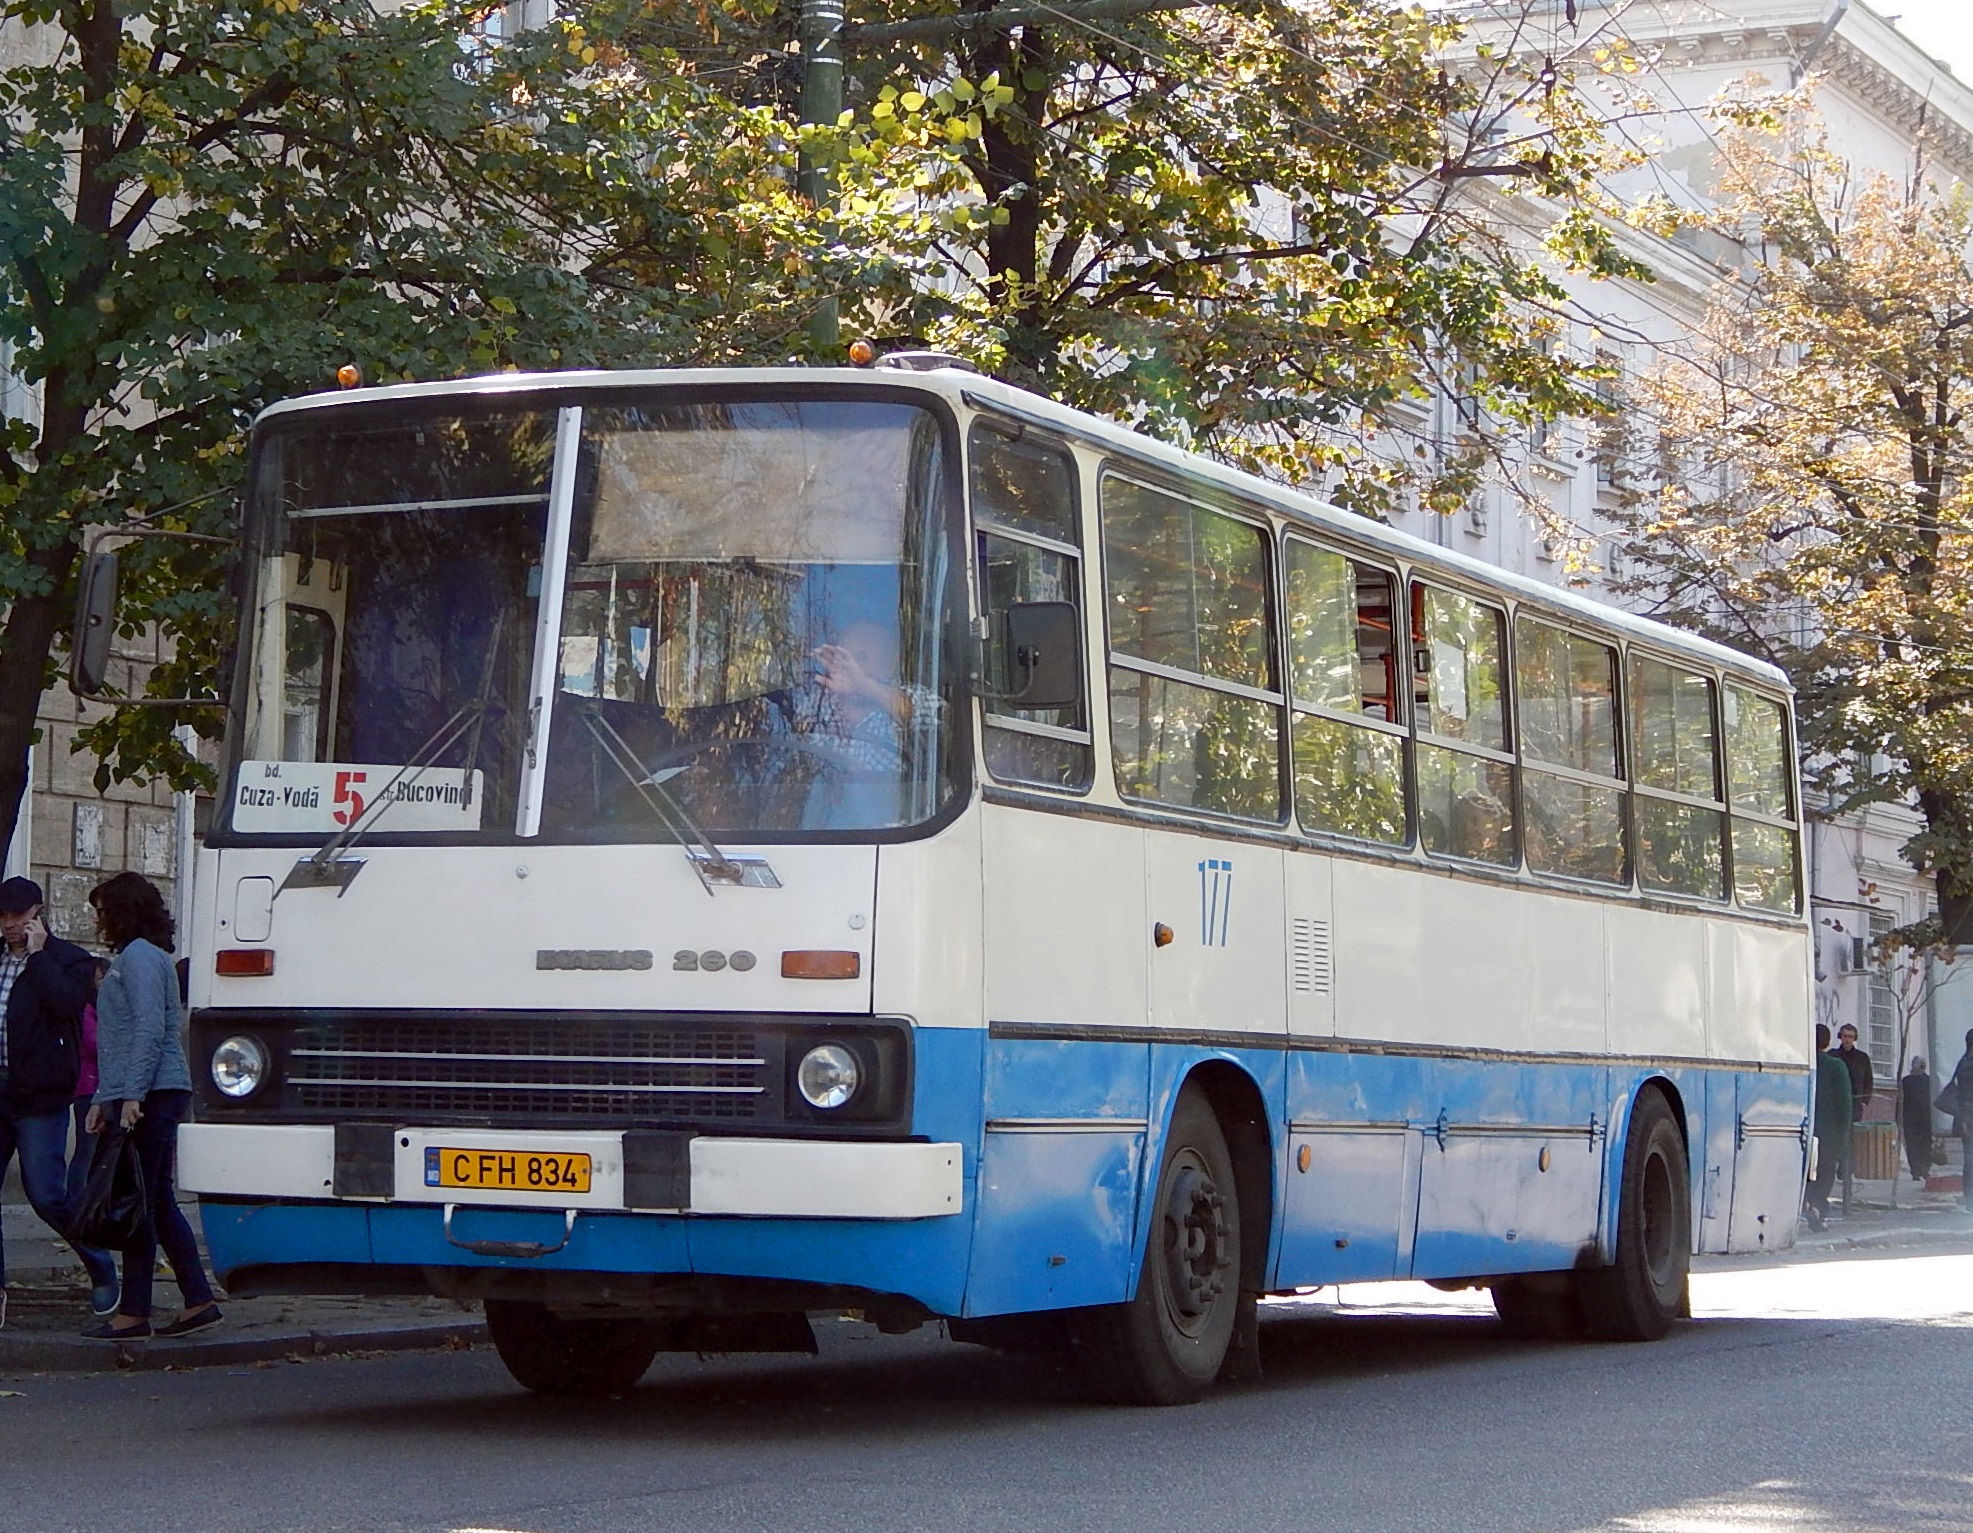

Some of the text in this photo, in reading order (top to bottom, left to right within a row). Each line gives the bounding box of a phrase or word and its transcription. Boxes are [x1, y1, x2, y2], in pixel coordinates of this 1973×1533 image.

[264, 763, 282, 778] bd.
[332, 771, 367, 830] 5
[1198, 859, 1232, 947] 177
[536, 949, 757, 972] IKARUS 260
[527, 1157, 578, 1187] 834
